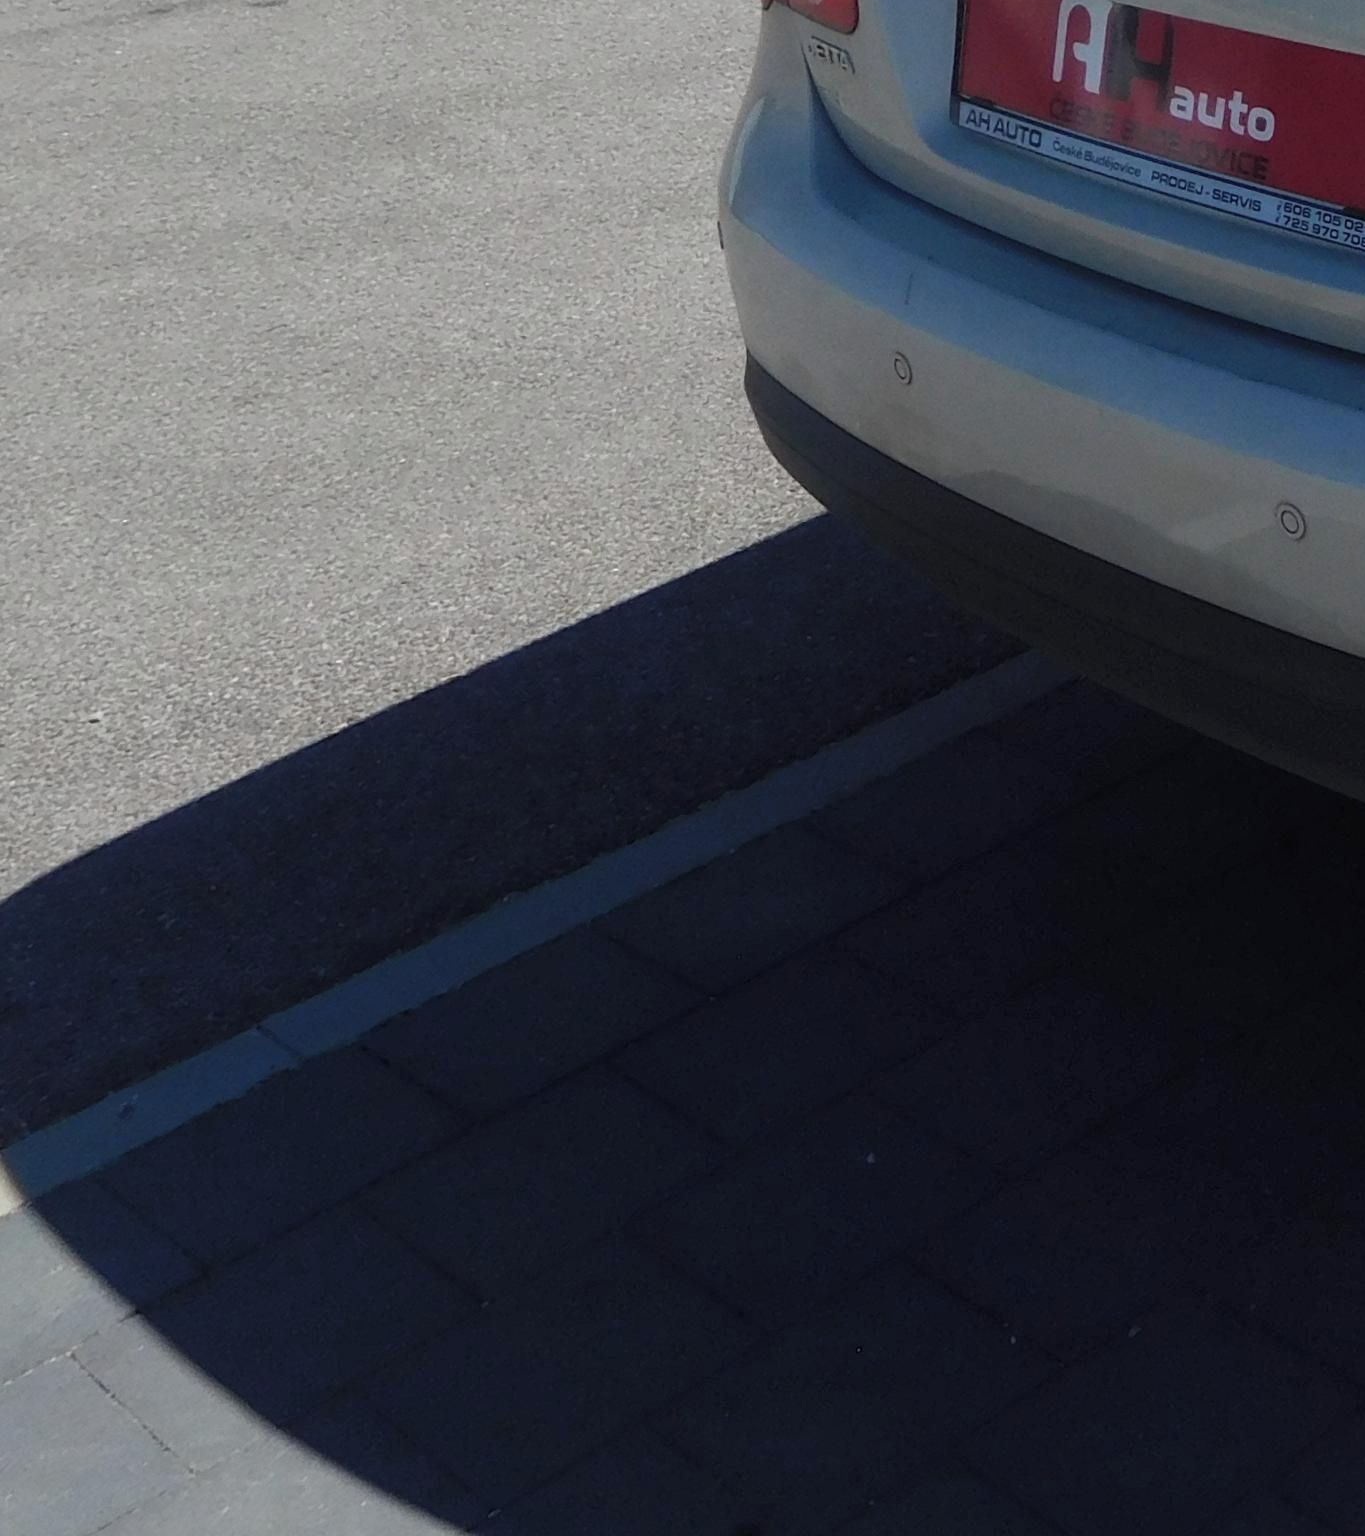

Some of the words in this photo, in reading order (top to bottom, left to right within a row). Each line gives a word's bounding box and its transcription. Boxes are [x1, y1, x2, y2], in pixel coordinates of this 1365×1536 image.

[1170, 85, 1275, 142] auto
[966, 109, 991, 131] AH
[993, 118, 1042, 148] AUTO
[1052, 137, 1084, 160] České
[1084, 151, 1142, 177] Budějovice
[1151, 170, 1204, 195] PRODEJ
[1212, 188, 1262, 212] SERVIS
[1283, 202, 1311, 219] 606
[1316, 210, 1340, 227] 105
[1283, 216, 1309, 232] 725
[1312, 223, 1339, 241] 970
